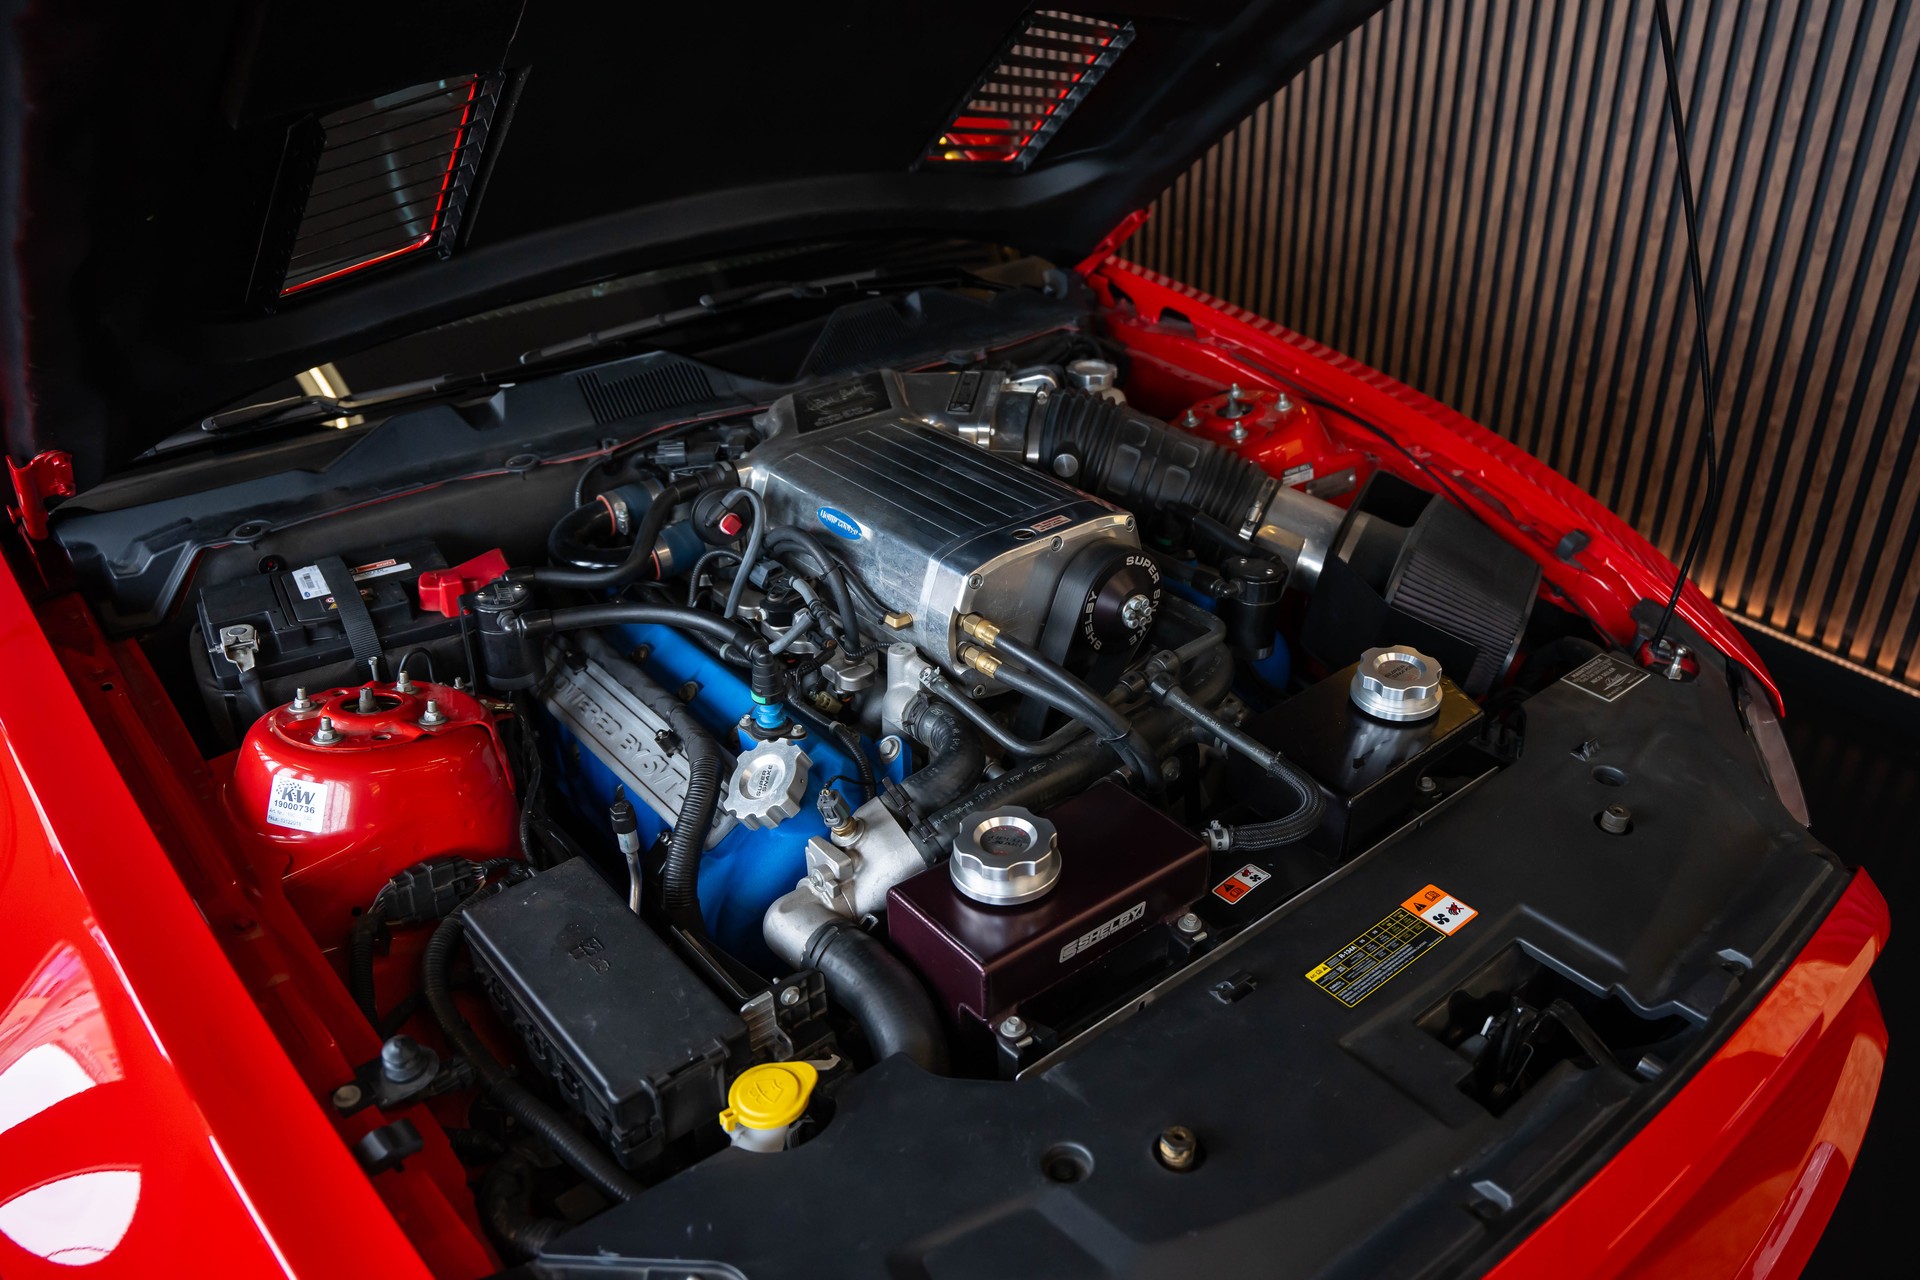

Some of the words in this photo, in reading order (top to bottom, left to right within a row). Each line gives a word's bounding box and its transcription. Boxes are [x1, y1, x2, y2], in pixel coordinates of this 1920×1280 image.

[1126, 556, 1160, 584] SUPER
[1085, 590, 1102, 650] SHELBY
[756, 770, 767, 796] SUPER
[762, 765, 773, 792] SNAKE
[275, 800, 315, 814] 19000736
[282, 787, 316, 805] KW
[1078, 905, 1143, 947] SHELBY
